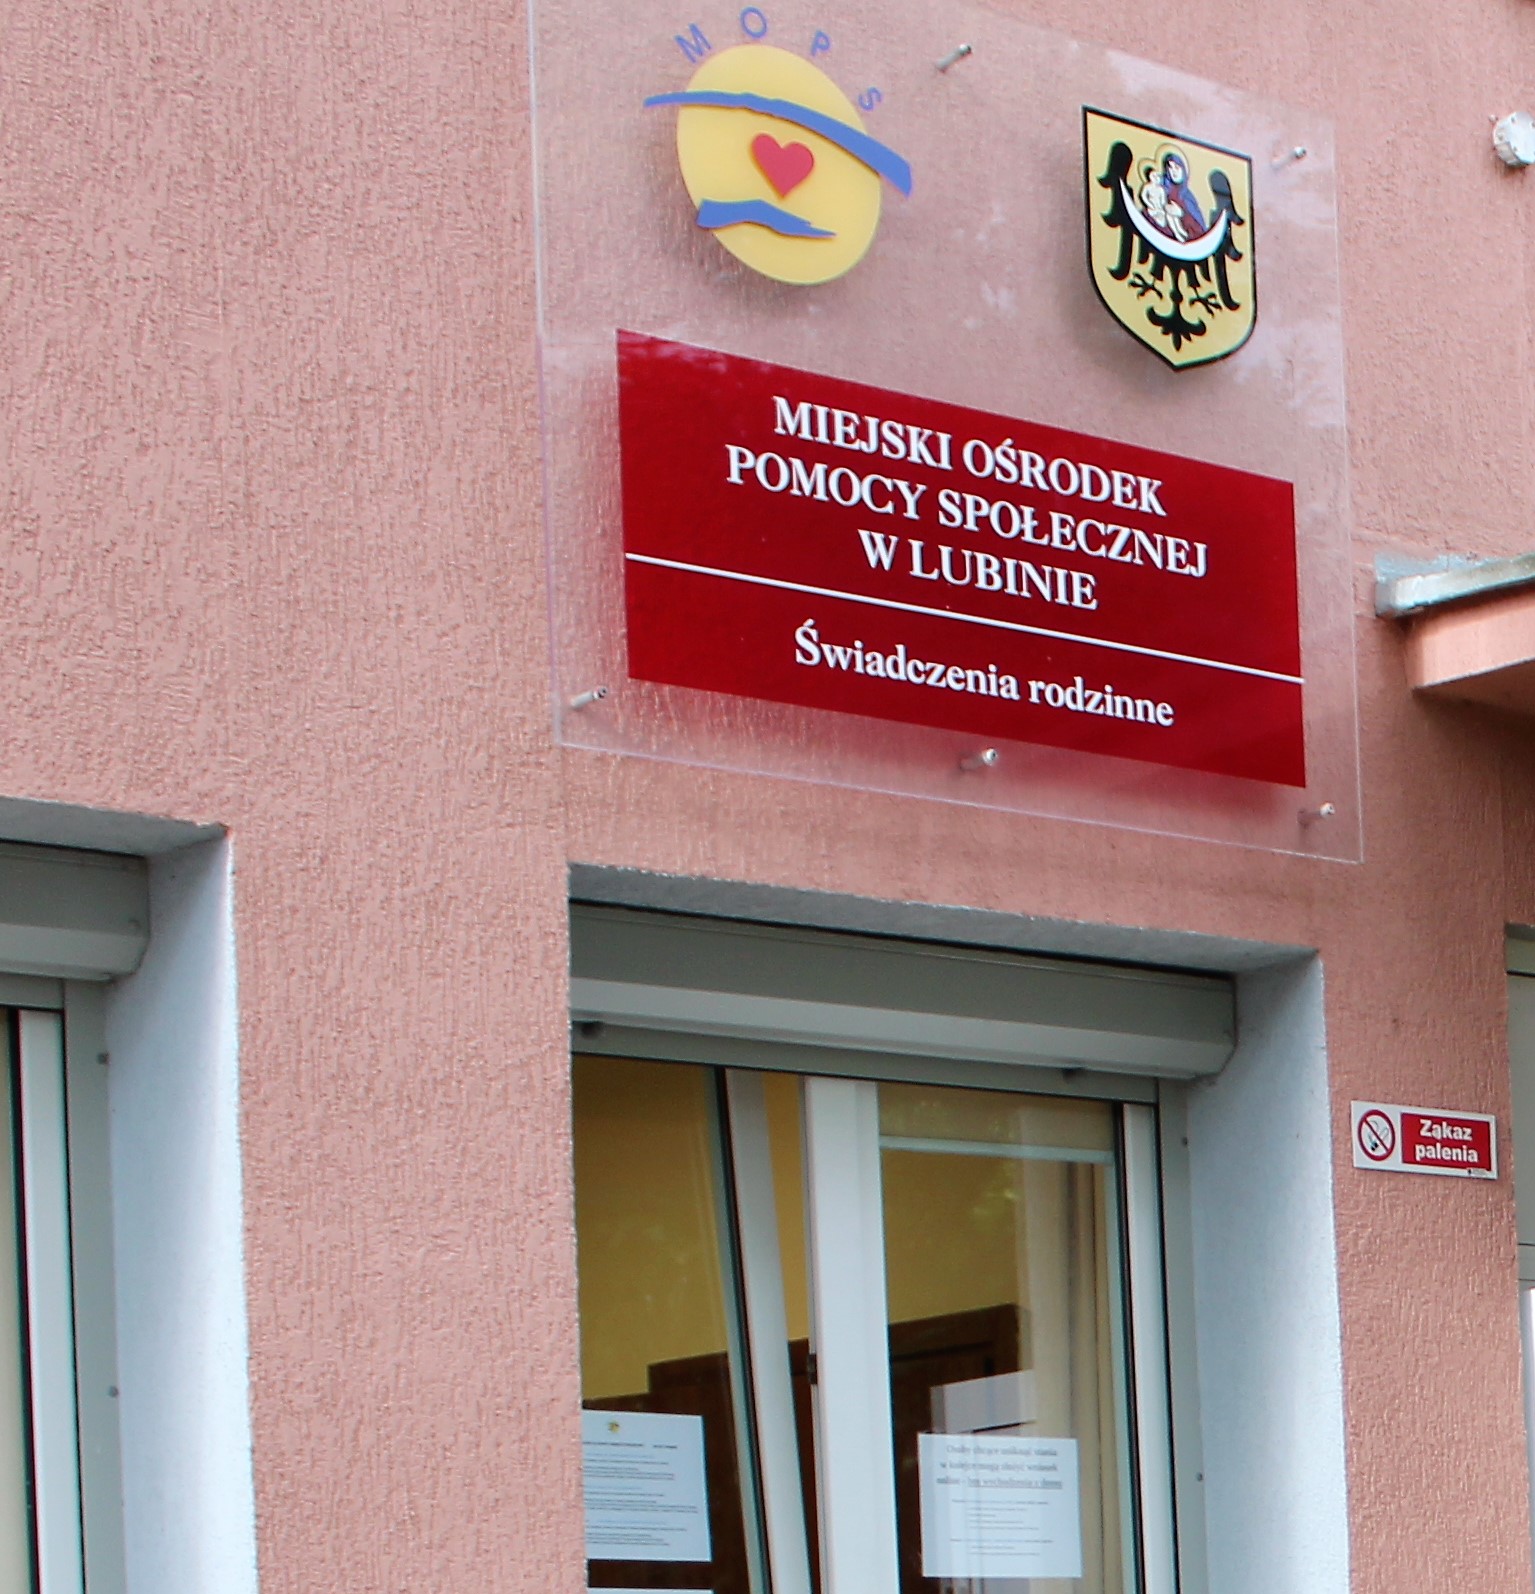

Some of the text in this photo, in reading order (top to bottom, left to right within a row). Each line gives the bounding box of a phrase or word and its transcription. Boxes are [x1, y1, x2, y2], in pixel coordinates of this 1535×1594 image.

[773, 395, 1168, 516] MIEJSKI OŚRODEK
[725, 443, 1208, 580] POMOCY SPOŁECZNEJ
[857, 528, 1099, 612] W LUBINIE
[794, 618, 1173, 727] Świadczenia rodzinne
[1415, 1143, 1478, 1162] palenia
